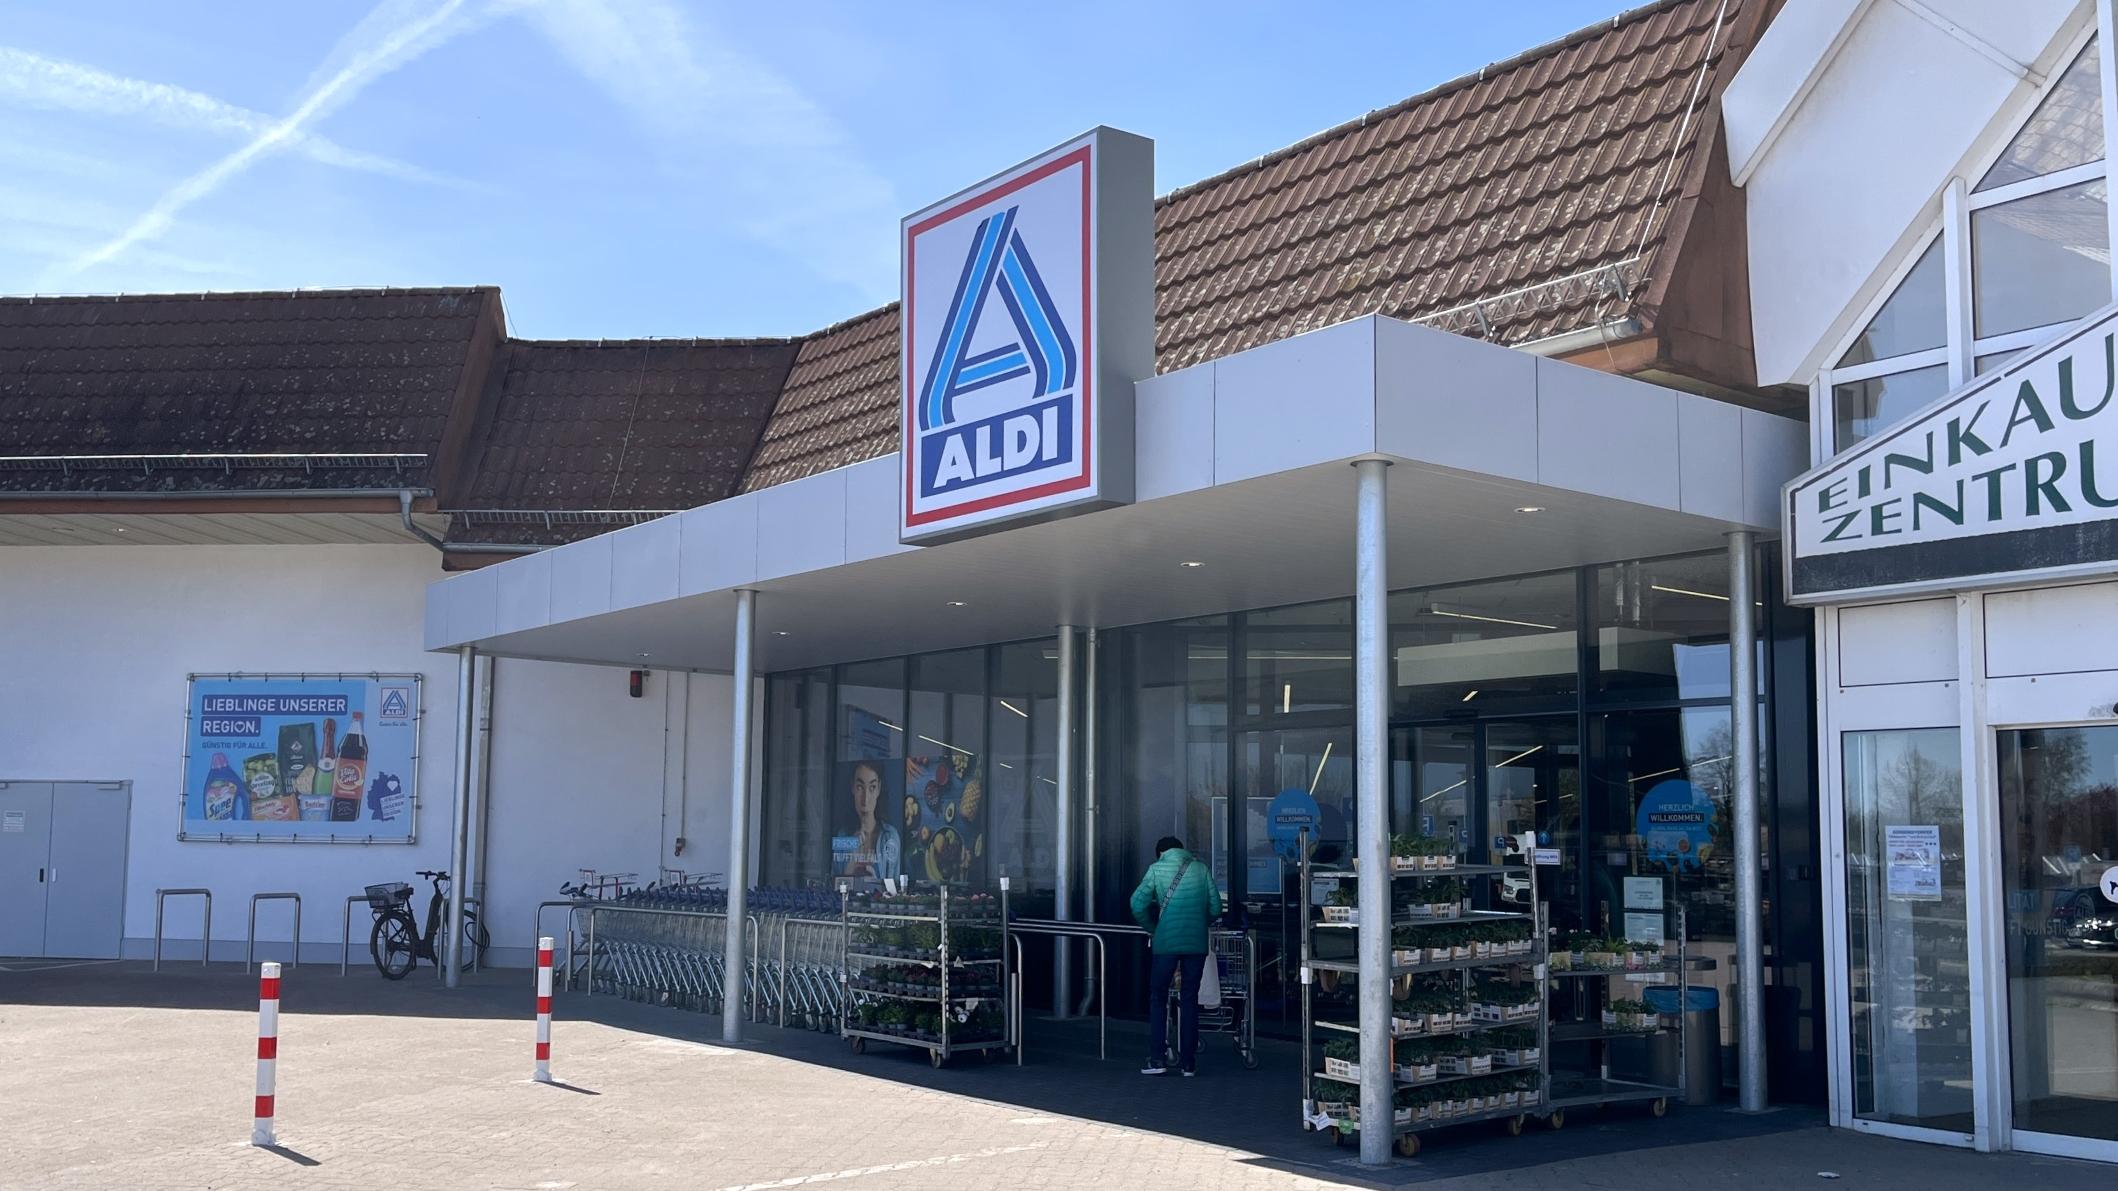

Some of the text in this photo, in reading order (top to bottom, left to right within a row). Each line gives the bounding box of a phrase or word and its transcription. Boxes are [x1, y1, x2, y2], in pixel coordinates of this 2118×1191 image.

[1818, 333, 2115, 514] EINKAU
[932, 406, 1060, 489] ALDI
[204, 699, 346, 712] LIEBLINGE UNSERER
[203, 720, 259, 733] REGION.
[202, 740, 231, 749] GÜNSTIG
[233, 740, 246, 749] FÜR
